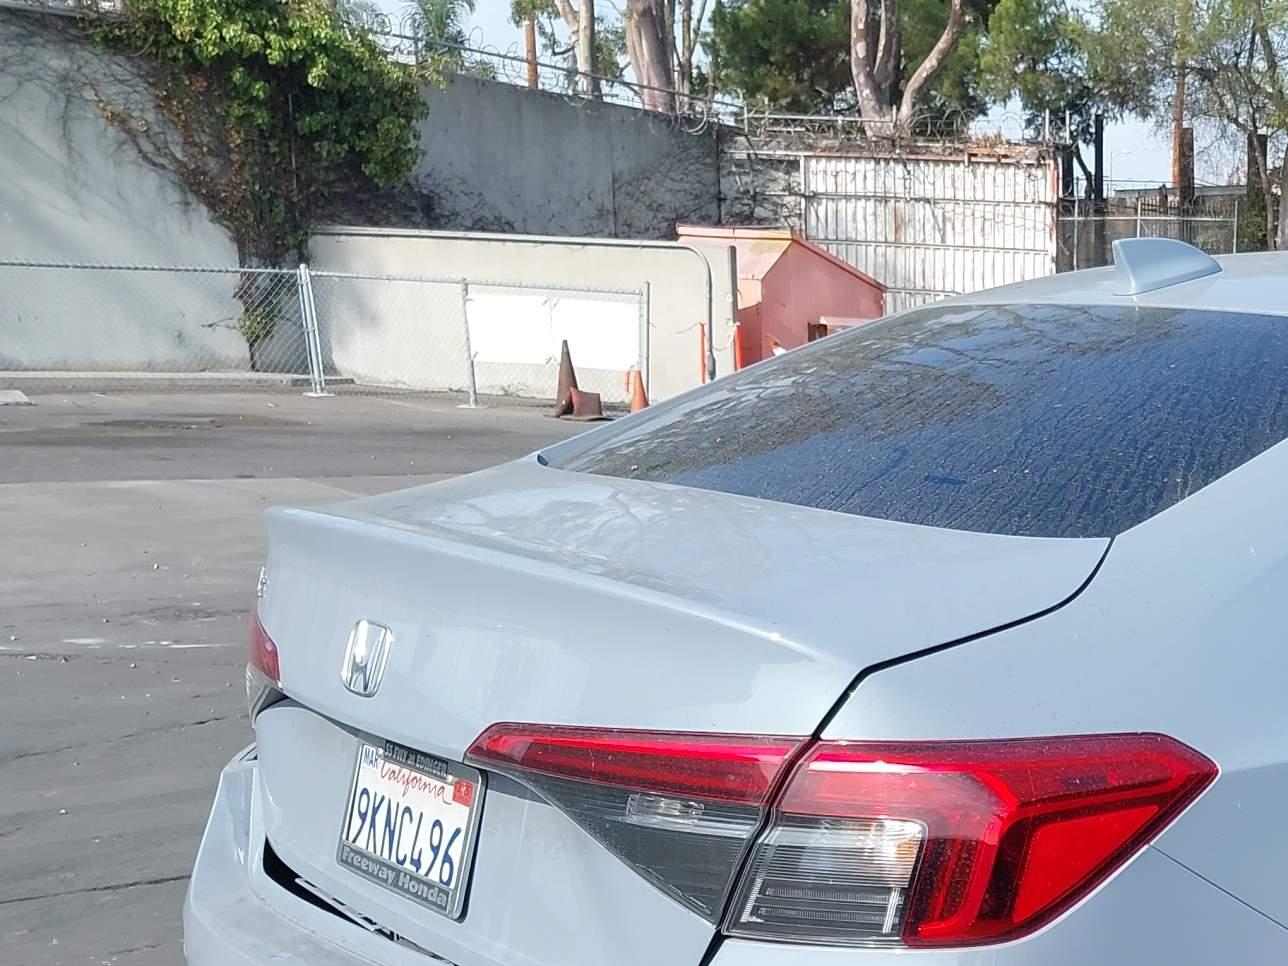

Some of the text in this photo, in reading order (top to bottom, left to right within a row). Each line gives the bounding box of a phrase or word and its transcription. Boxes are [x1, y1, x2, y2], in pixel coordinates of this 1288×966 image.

[380, 760, 452, 804] California
[352, 788, 461, 886] 9KNC496
[341, 845, 448, 907] Freeway Honda
